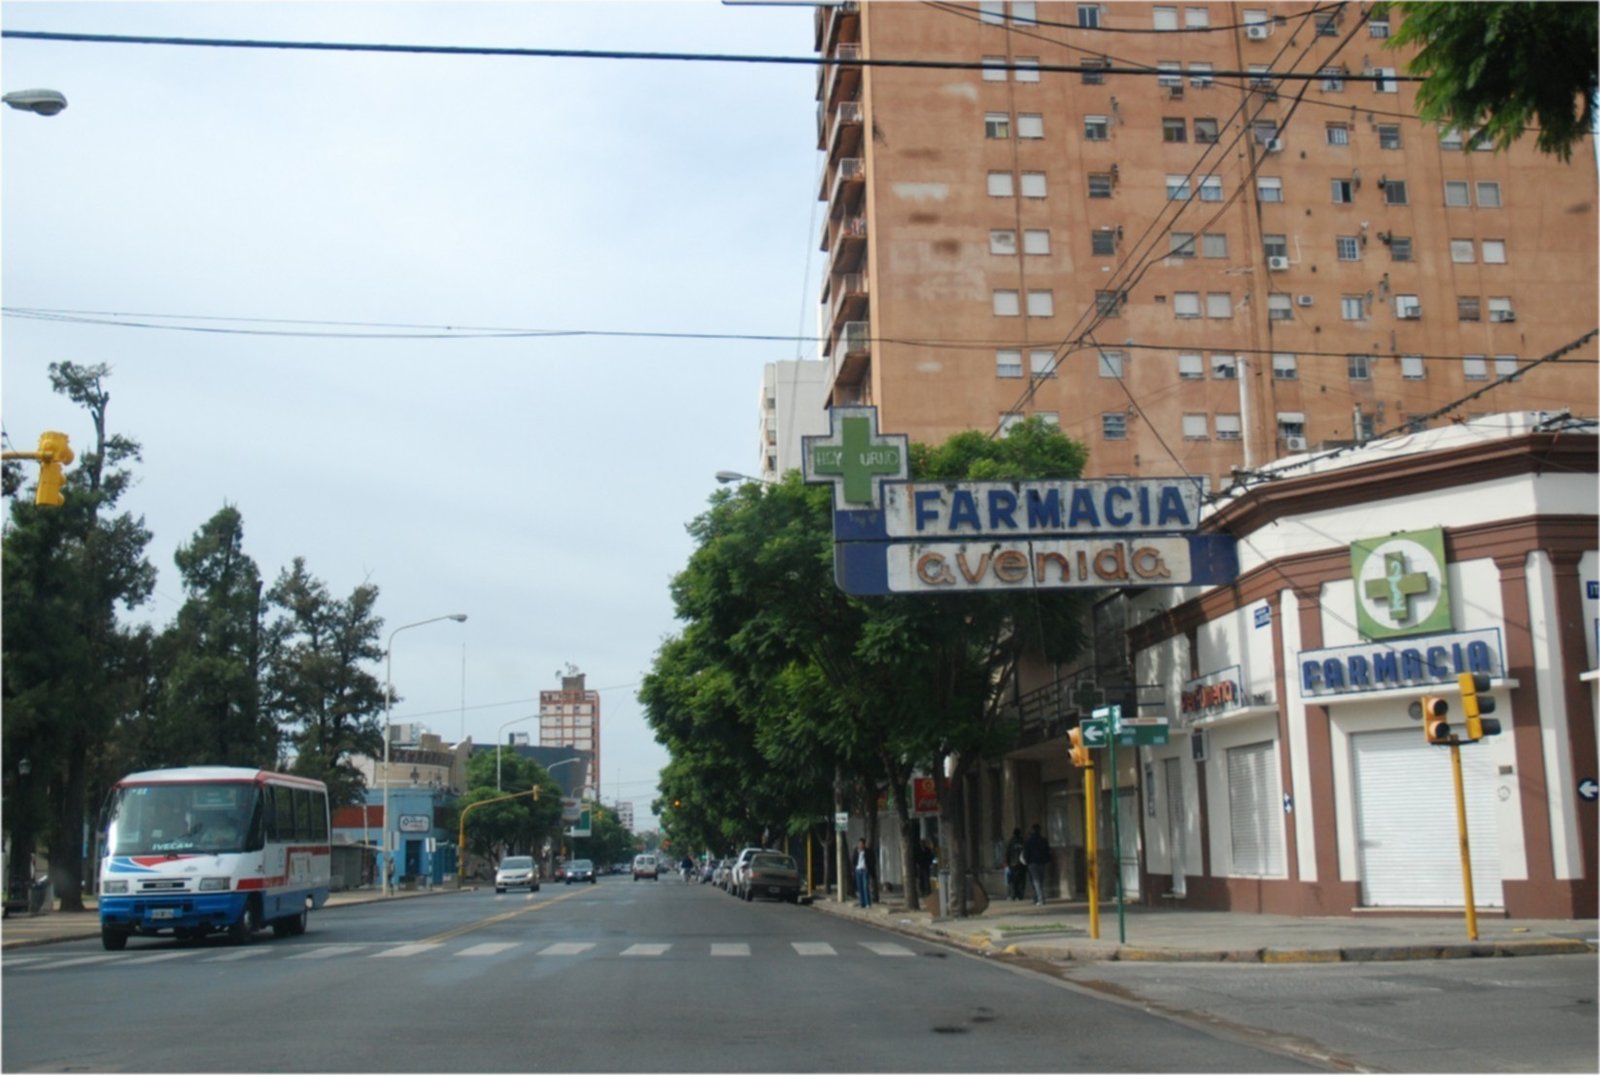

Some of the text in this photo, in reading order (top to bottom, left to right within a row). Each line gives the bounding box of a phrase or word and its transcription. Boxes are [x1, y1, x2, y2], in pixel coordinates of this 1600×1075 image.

[858, 451, 899, 467] URNO
[913, 485, 1191, 531] FARMACIA
[916, 542, 1172, 585] avenida
[1302, 639, 1492, 691] FARMACIA
